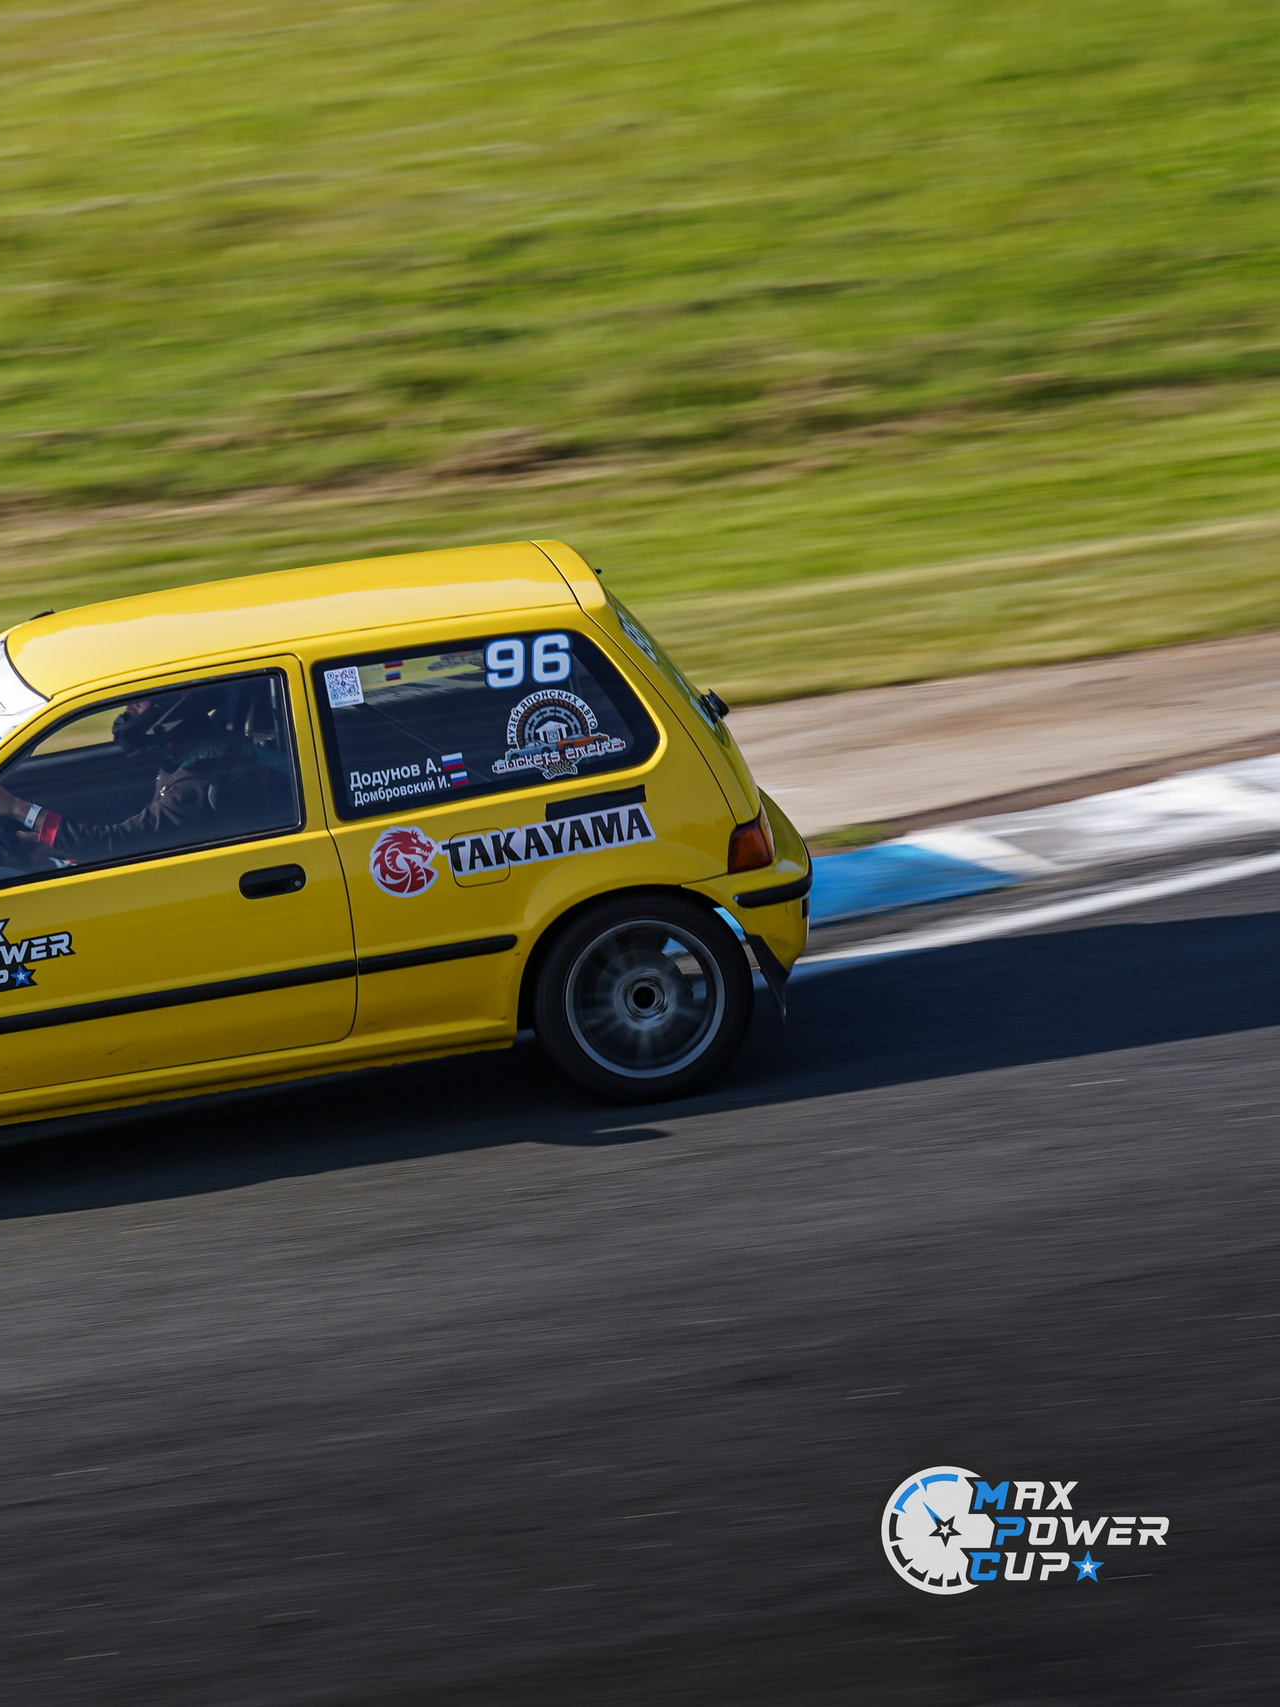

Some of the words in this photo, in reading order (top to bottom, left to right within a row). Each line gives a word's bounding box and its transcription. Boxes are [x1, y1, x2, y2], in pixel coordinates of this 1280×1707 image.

[485, 633, 572, 689] 96
[508, 709, 522, 742] МУЗЕЙ
[521, 690, 579, 710] ЯПОНСКИХ
[580, 703, 597, 730] АВТО
[349, 764, 421, 791] Додунов
[425, 757, 442, 775] А.
[354, 777, 436, 807] Домбровский
[437, 775, 451, 789] И.
[442, 808, 654, 872] TAKAYAMA
